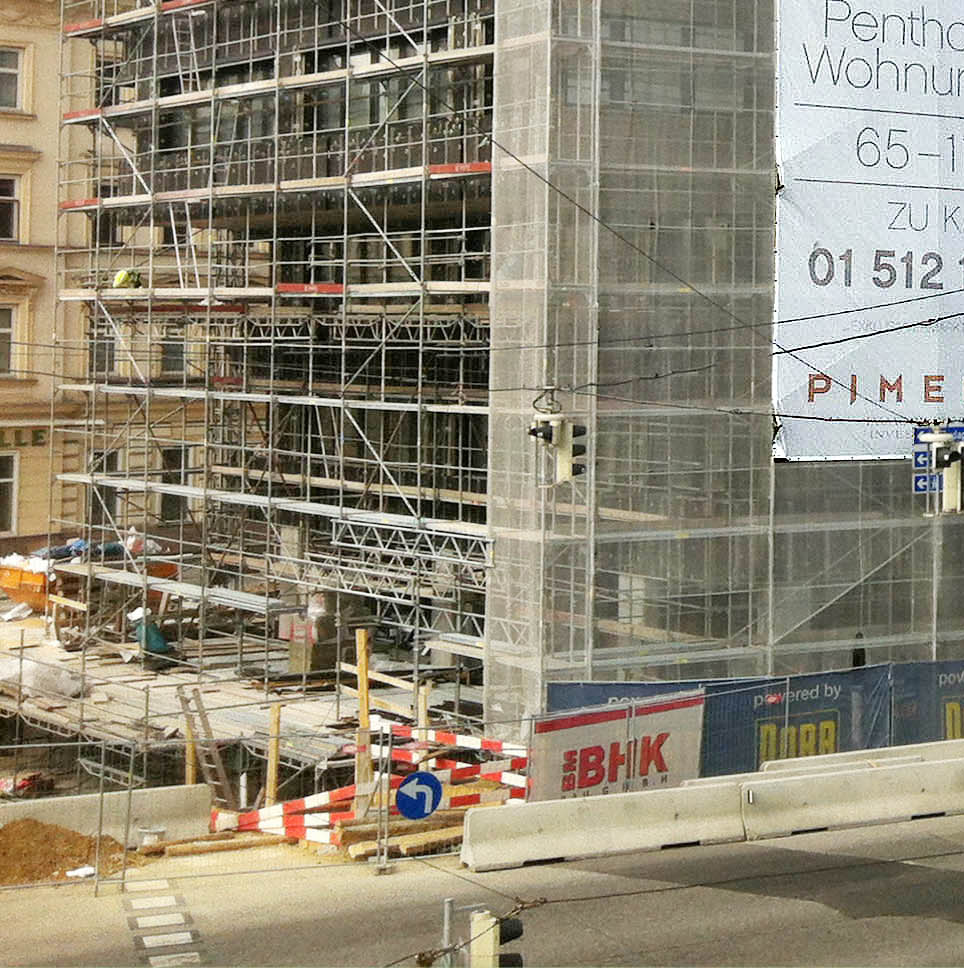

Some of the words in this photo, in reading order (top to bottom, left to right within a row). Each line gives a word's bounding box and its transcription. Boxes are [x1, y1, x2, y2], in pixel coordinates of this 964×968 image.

[887, 201, 929, 232] ZU
[808, 246, 853, 288] 01
[871, 249, 944, 290] 512
[824, 684, 841, 700] by
[577, 732, 670, 789] BHK
